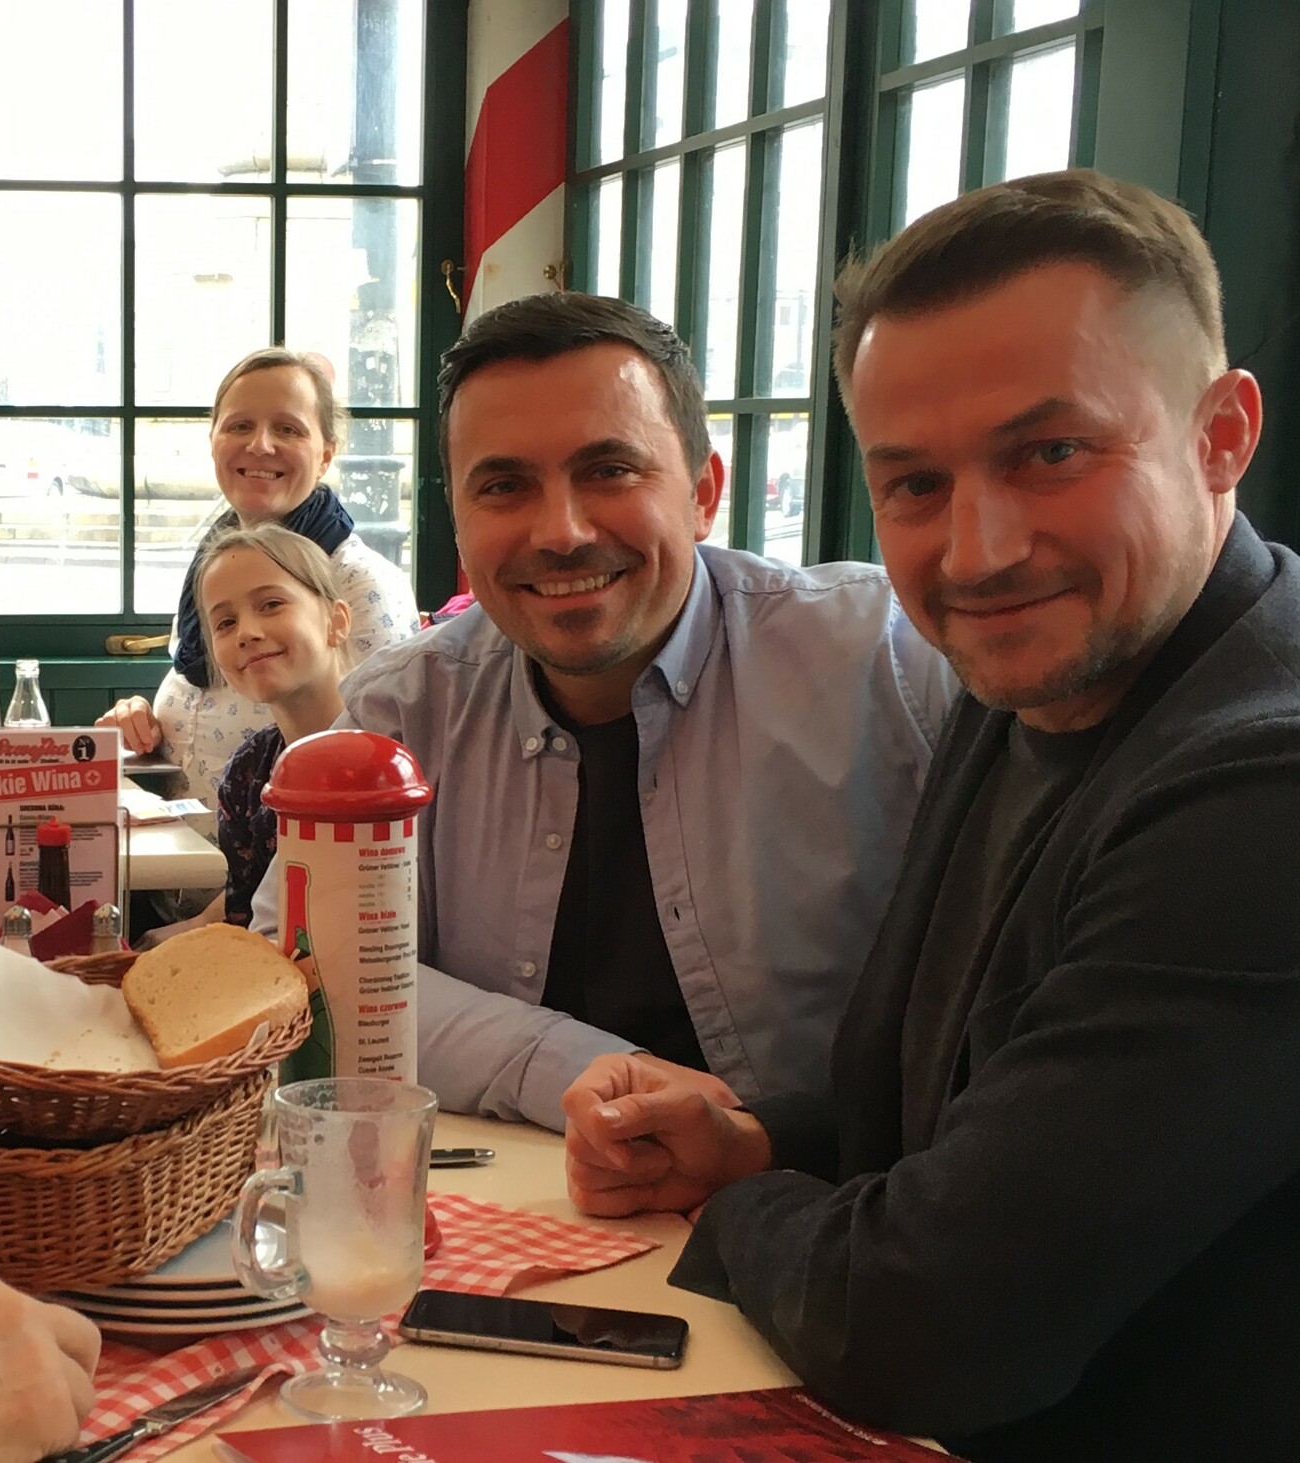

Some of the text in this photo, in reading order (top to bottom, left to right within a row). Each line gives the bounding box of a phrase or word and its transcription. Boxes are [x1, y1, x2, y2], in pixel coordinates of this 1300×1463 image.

[77, 747, 90, 761] 1
[30, 769, 82, 793] Wina
[358, 848, 379, 857] Wina
[358, 1004, 378, 1014] Wina
